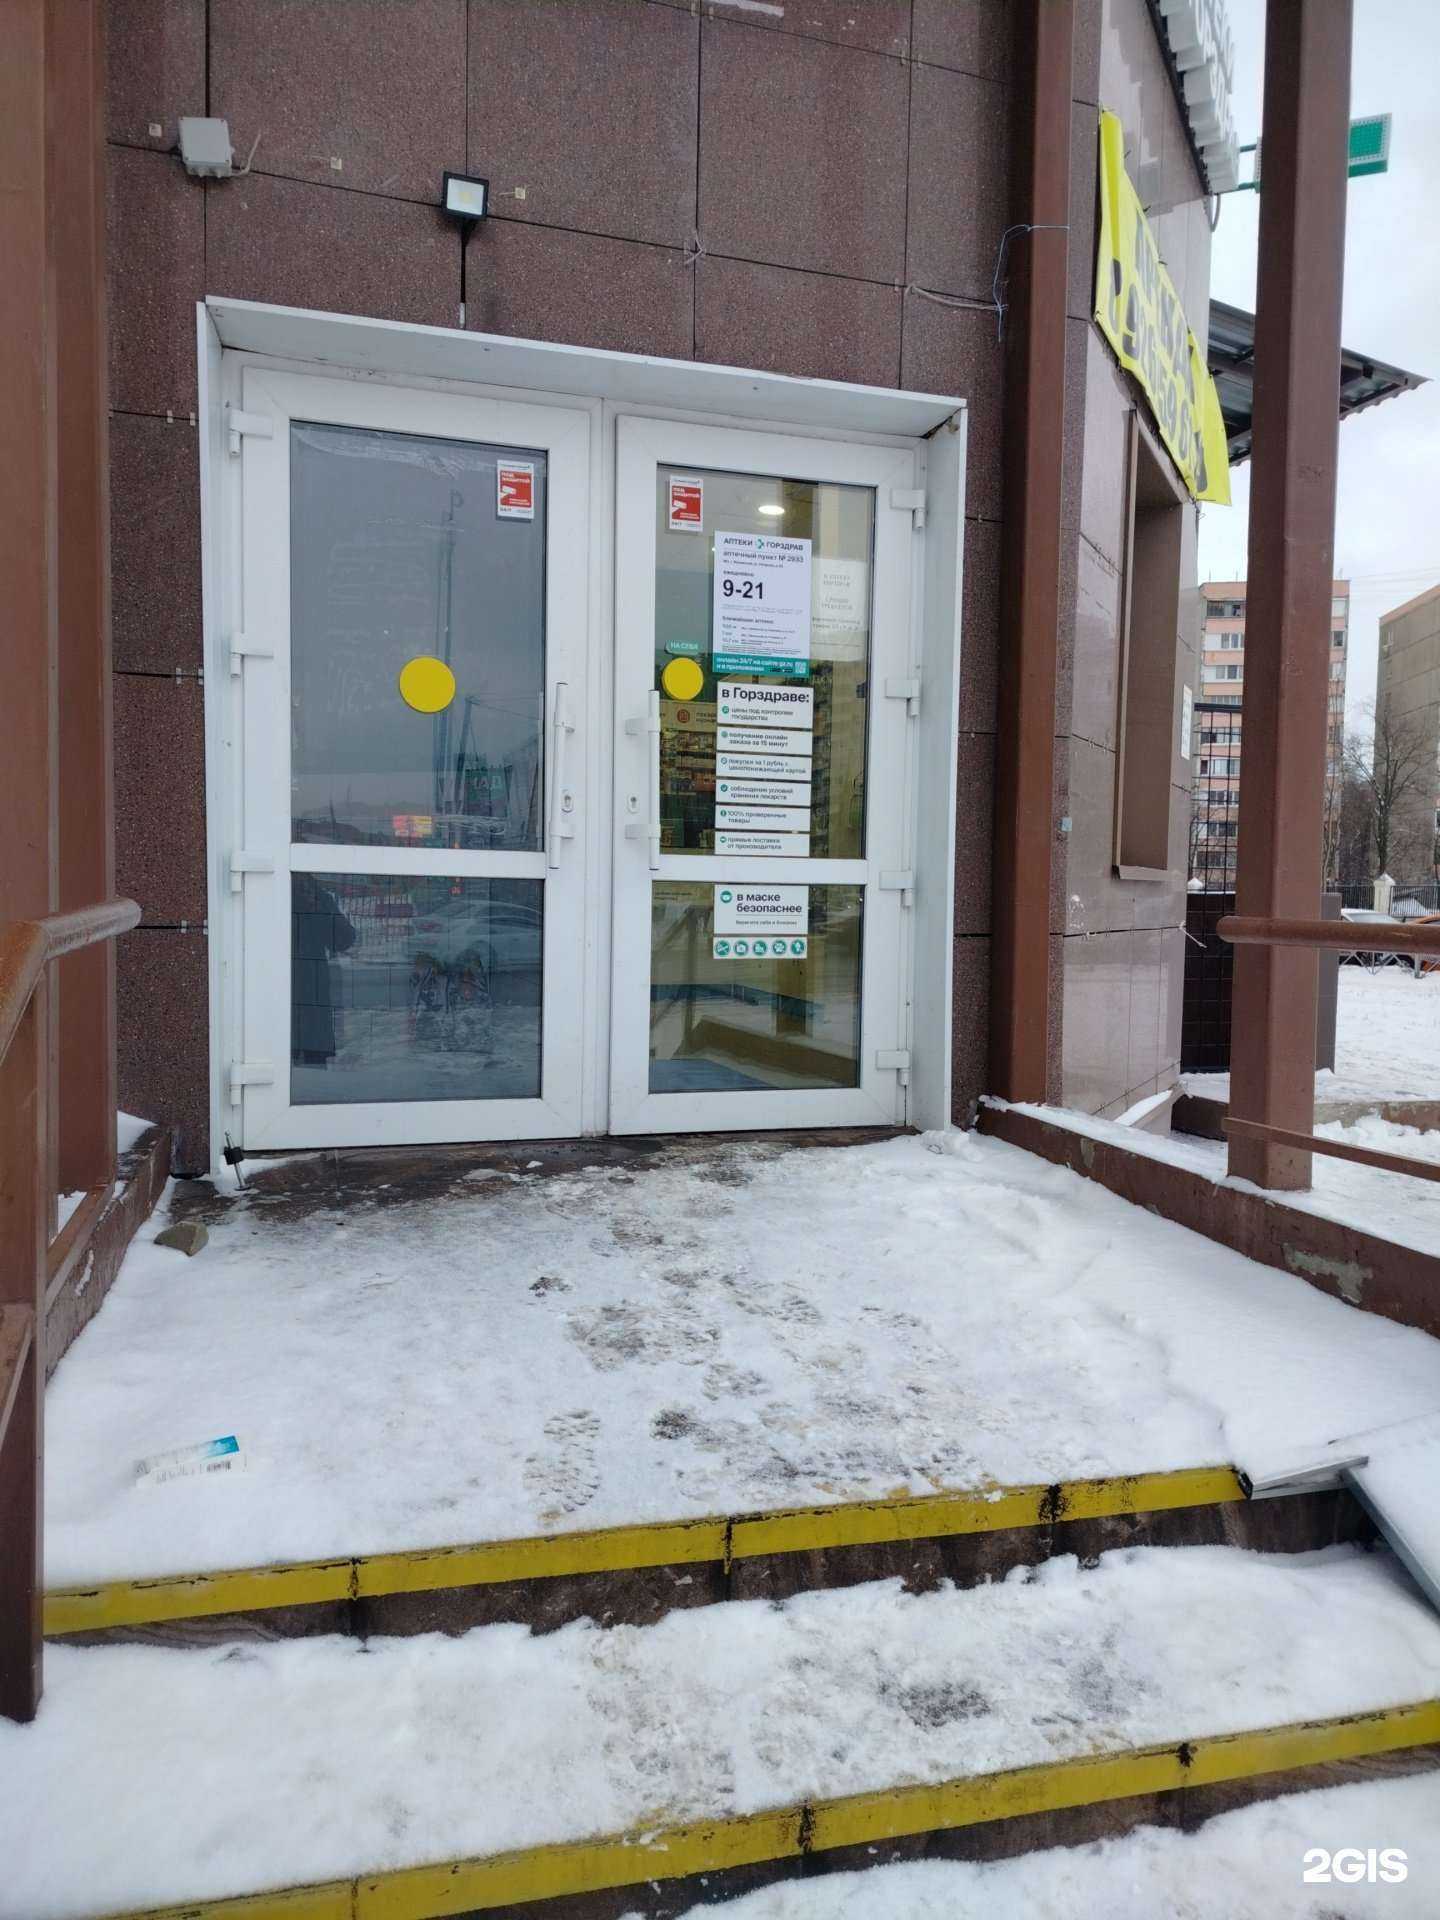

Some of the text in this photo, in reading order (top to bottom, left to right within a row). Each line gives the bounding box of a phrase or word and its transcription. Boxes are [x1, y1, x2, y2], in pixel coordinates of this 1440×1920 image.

[723, 537, 804, 551] АПТЕКИ ГОРЗДРАВ
[723, 551, 757, 560] аптечный
[758, 553, 777, 561] пункт
[723, 579, 764, 600] 9-21
[722, 687, 810, 703] в Горздраве:
[729, 732, 788, 740] получение онлайн
[729, 758, 754, 766] покупки
[766, 760, 784, 768] рубль
[730, 785, 793, 795] соблюдение условий
[731, 793, 759, 801] хранения
[737, 893, 781, 902] в маске
[736, 903, 802, 913] безопаснее
